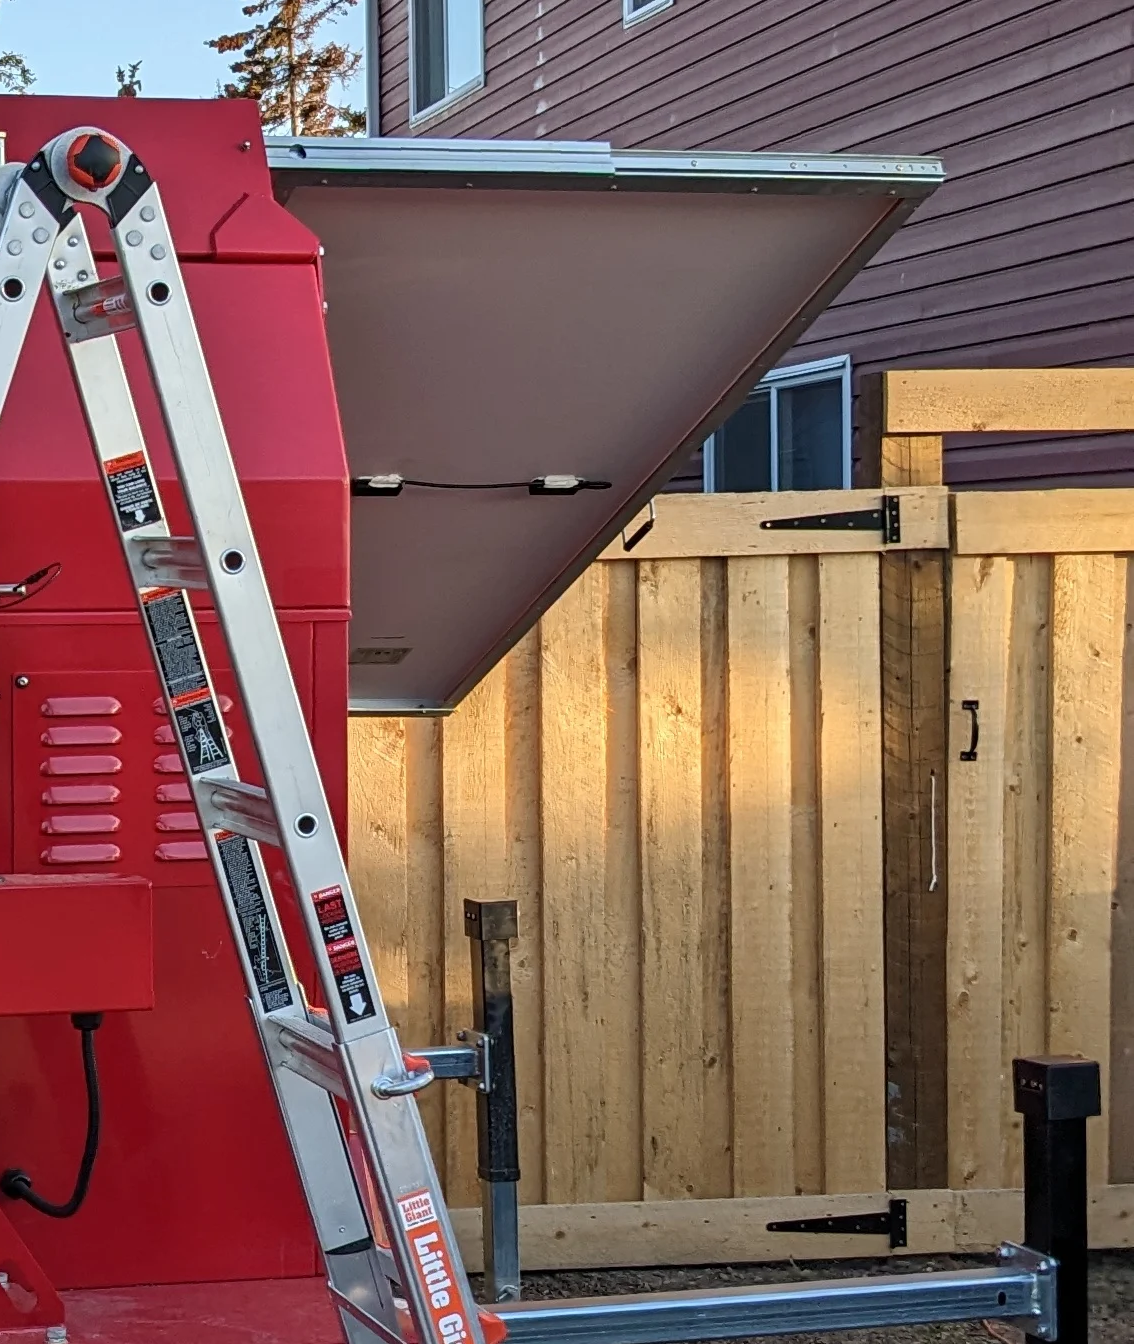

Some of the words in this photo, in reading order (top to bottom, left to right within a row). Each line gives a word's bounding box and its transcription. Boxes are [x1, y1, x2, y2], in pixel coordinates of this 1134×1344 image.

[318, 899, 342, 914] LAST
[401, 1197, 431, 1214] Little
[404, 1206, 433, 1223] Giant
[413, 1231, 451, 1310] Little
